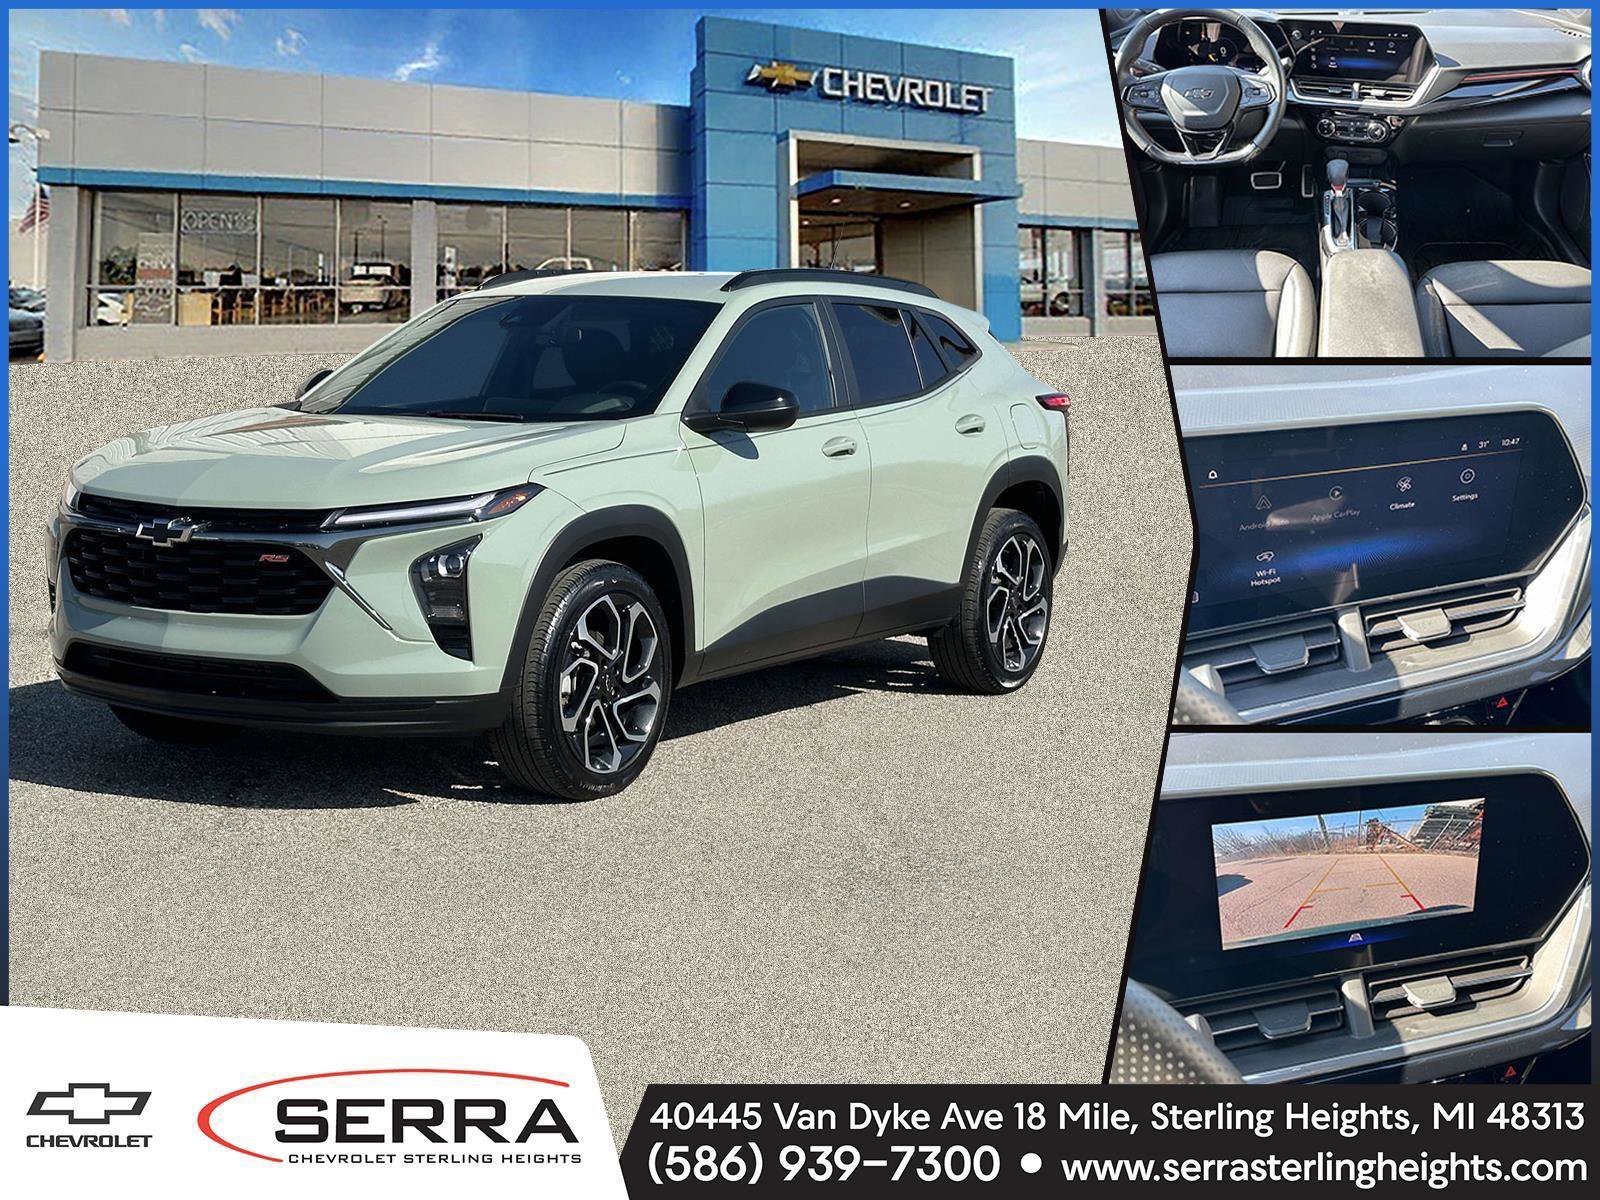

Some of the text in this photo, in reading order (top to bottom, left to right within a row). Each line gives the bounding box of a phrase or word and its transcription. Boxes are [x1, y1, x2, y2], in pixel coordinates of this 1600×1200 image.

[823, 67, 993, 112] CHEVROLET
[1501, 438, 1520, 447] 10:47
[1452, 493, 1478, 502] Settings
[1389, 501, 1415, 511] Climate
[1311, 508, 1361, 523] Apple CarPlay
[1239, 520, 1270, 532] Android
[259, 554, 289, 563] RS
[1255, 568, 1276, 577] Wi-Fi
[1250, 576, 1281, 588] Hotspot
